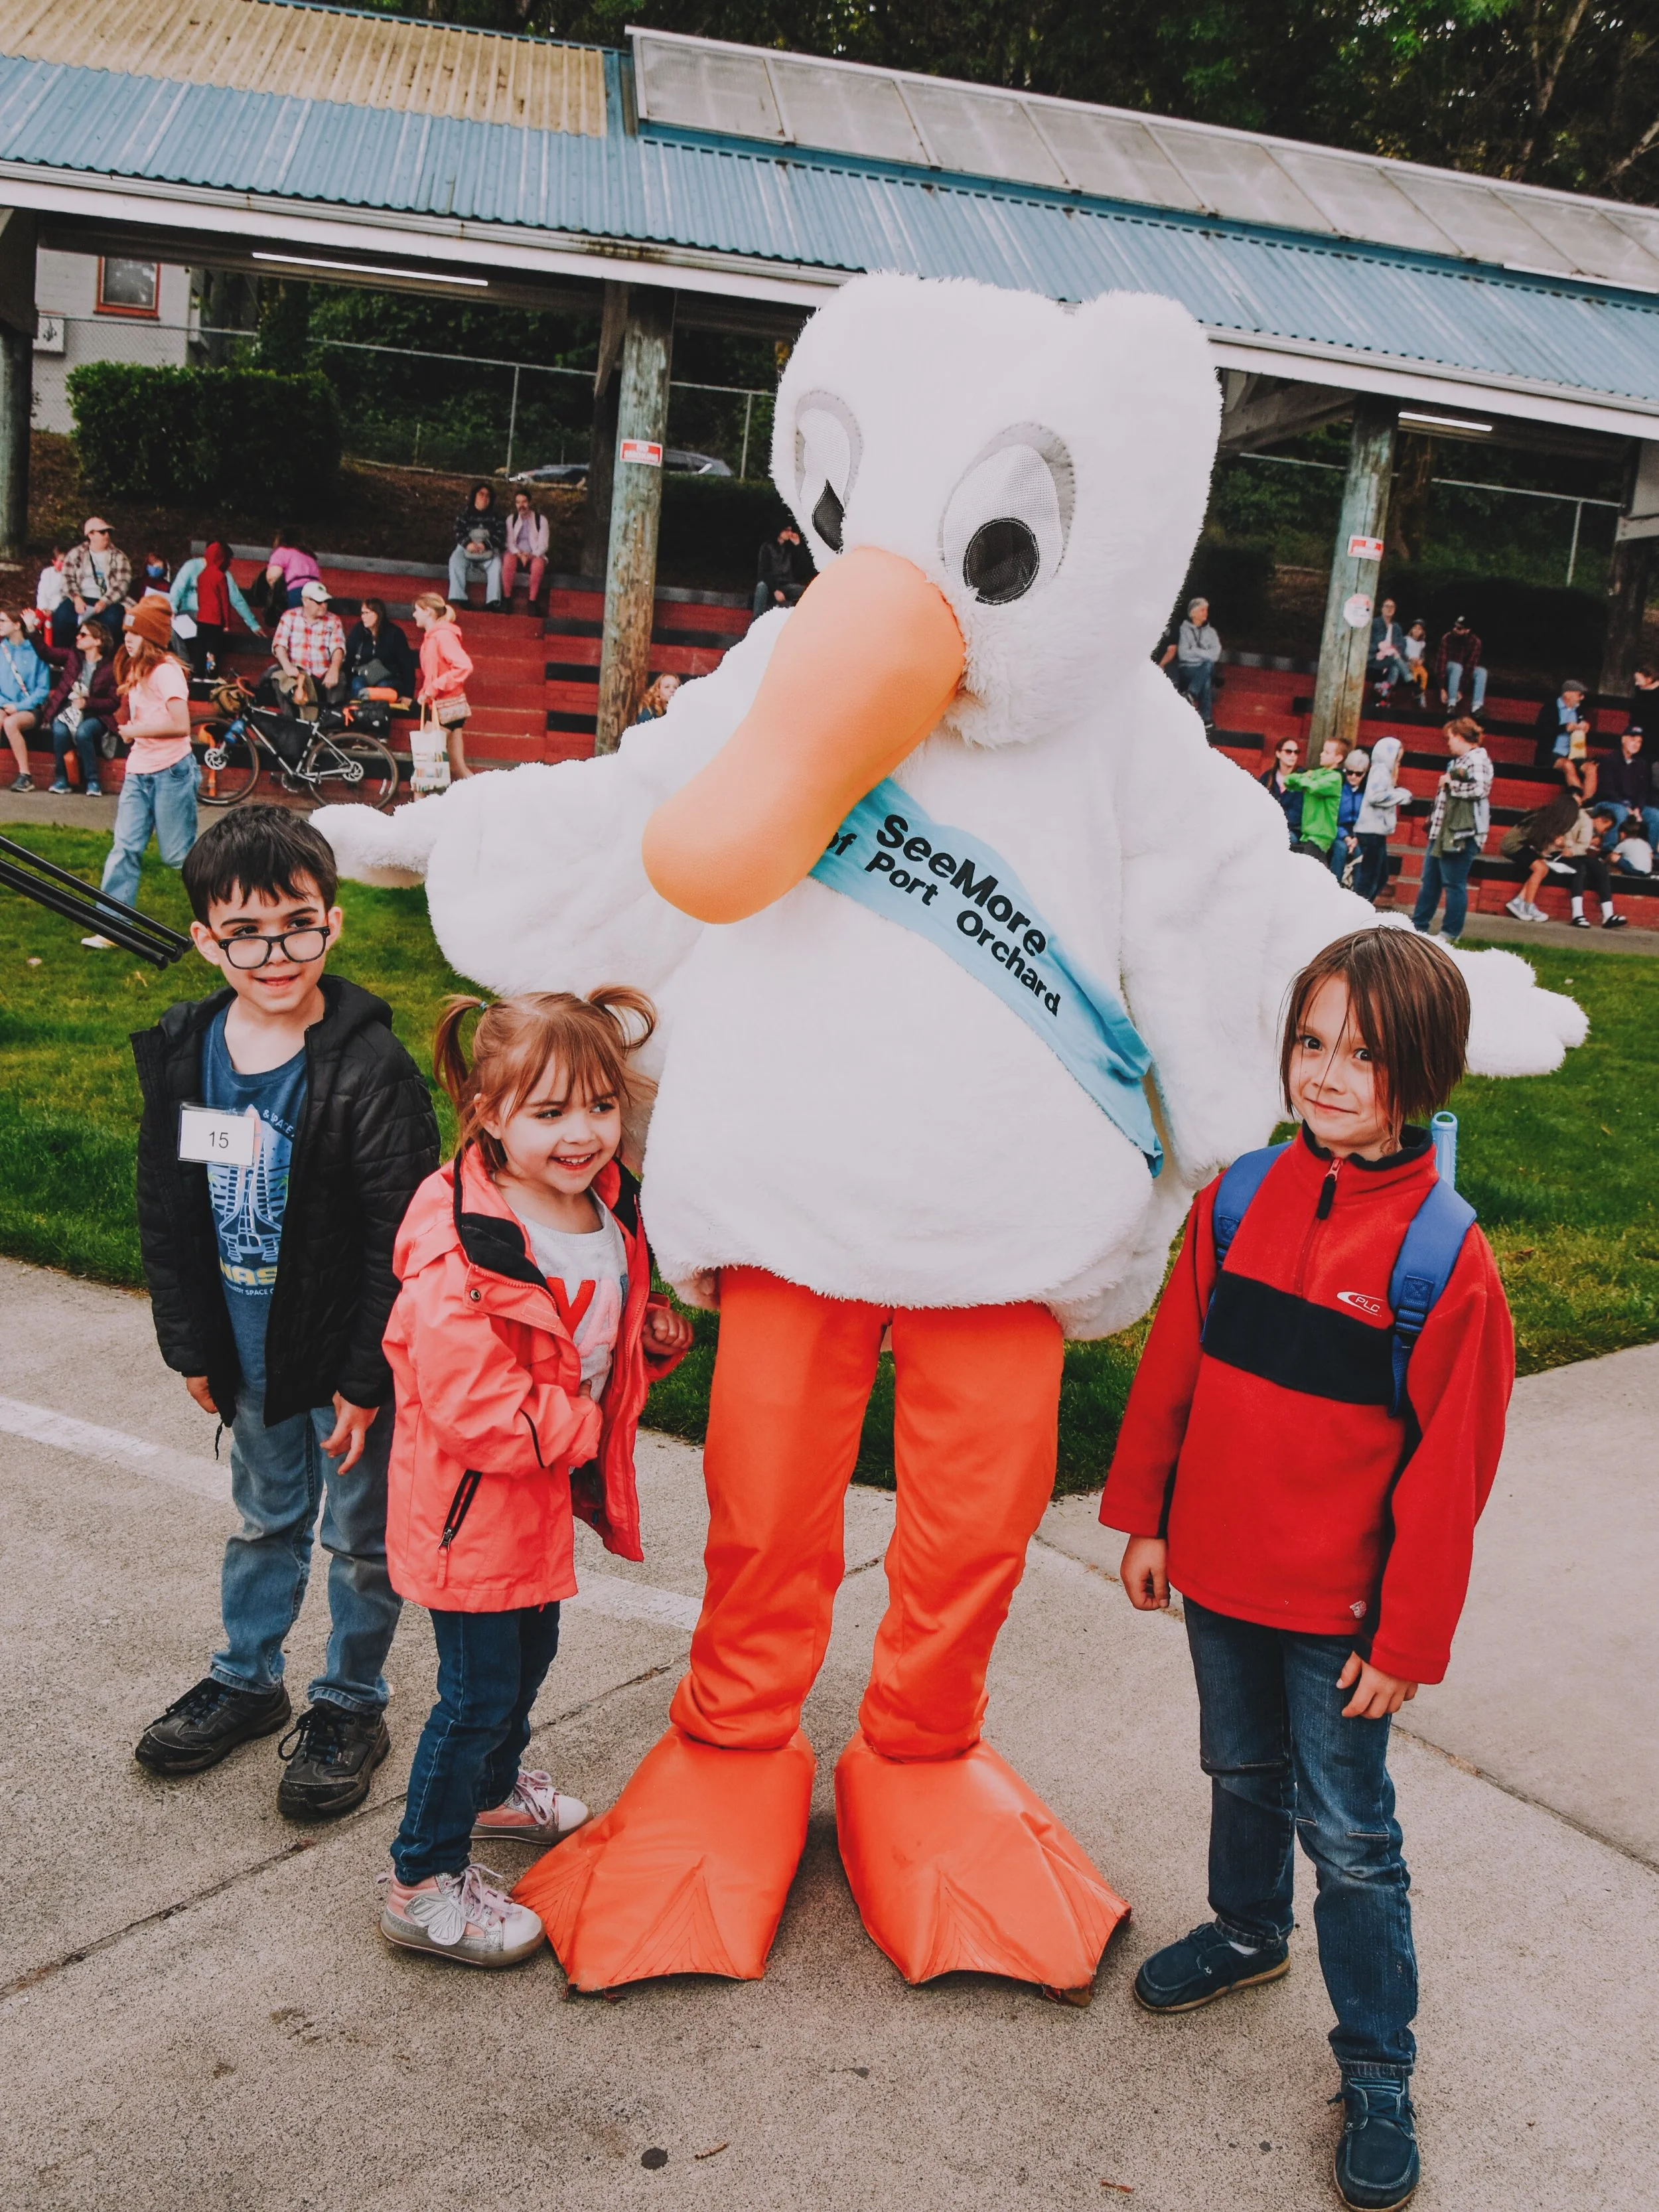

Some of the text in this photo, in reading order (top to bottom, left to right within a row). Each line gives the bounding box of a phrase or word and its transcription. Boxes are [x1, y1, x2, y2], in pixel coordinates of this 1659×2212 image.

[876, 814, 1046, 957] SeeMore
[864, 850, 938, 907] Port
[956, 910, 1061, 1017] Orchard
[209, 1131, 229, 1148] 15
[263, 1109, 269, 1119] &
